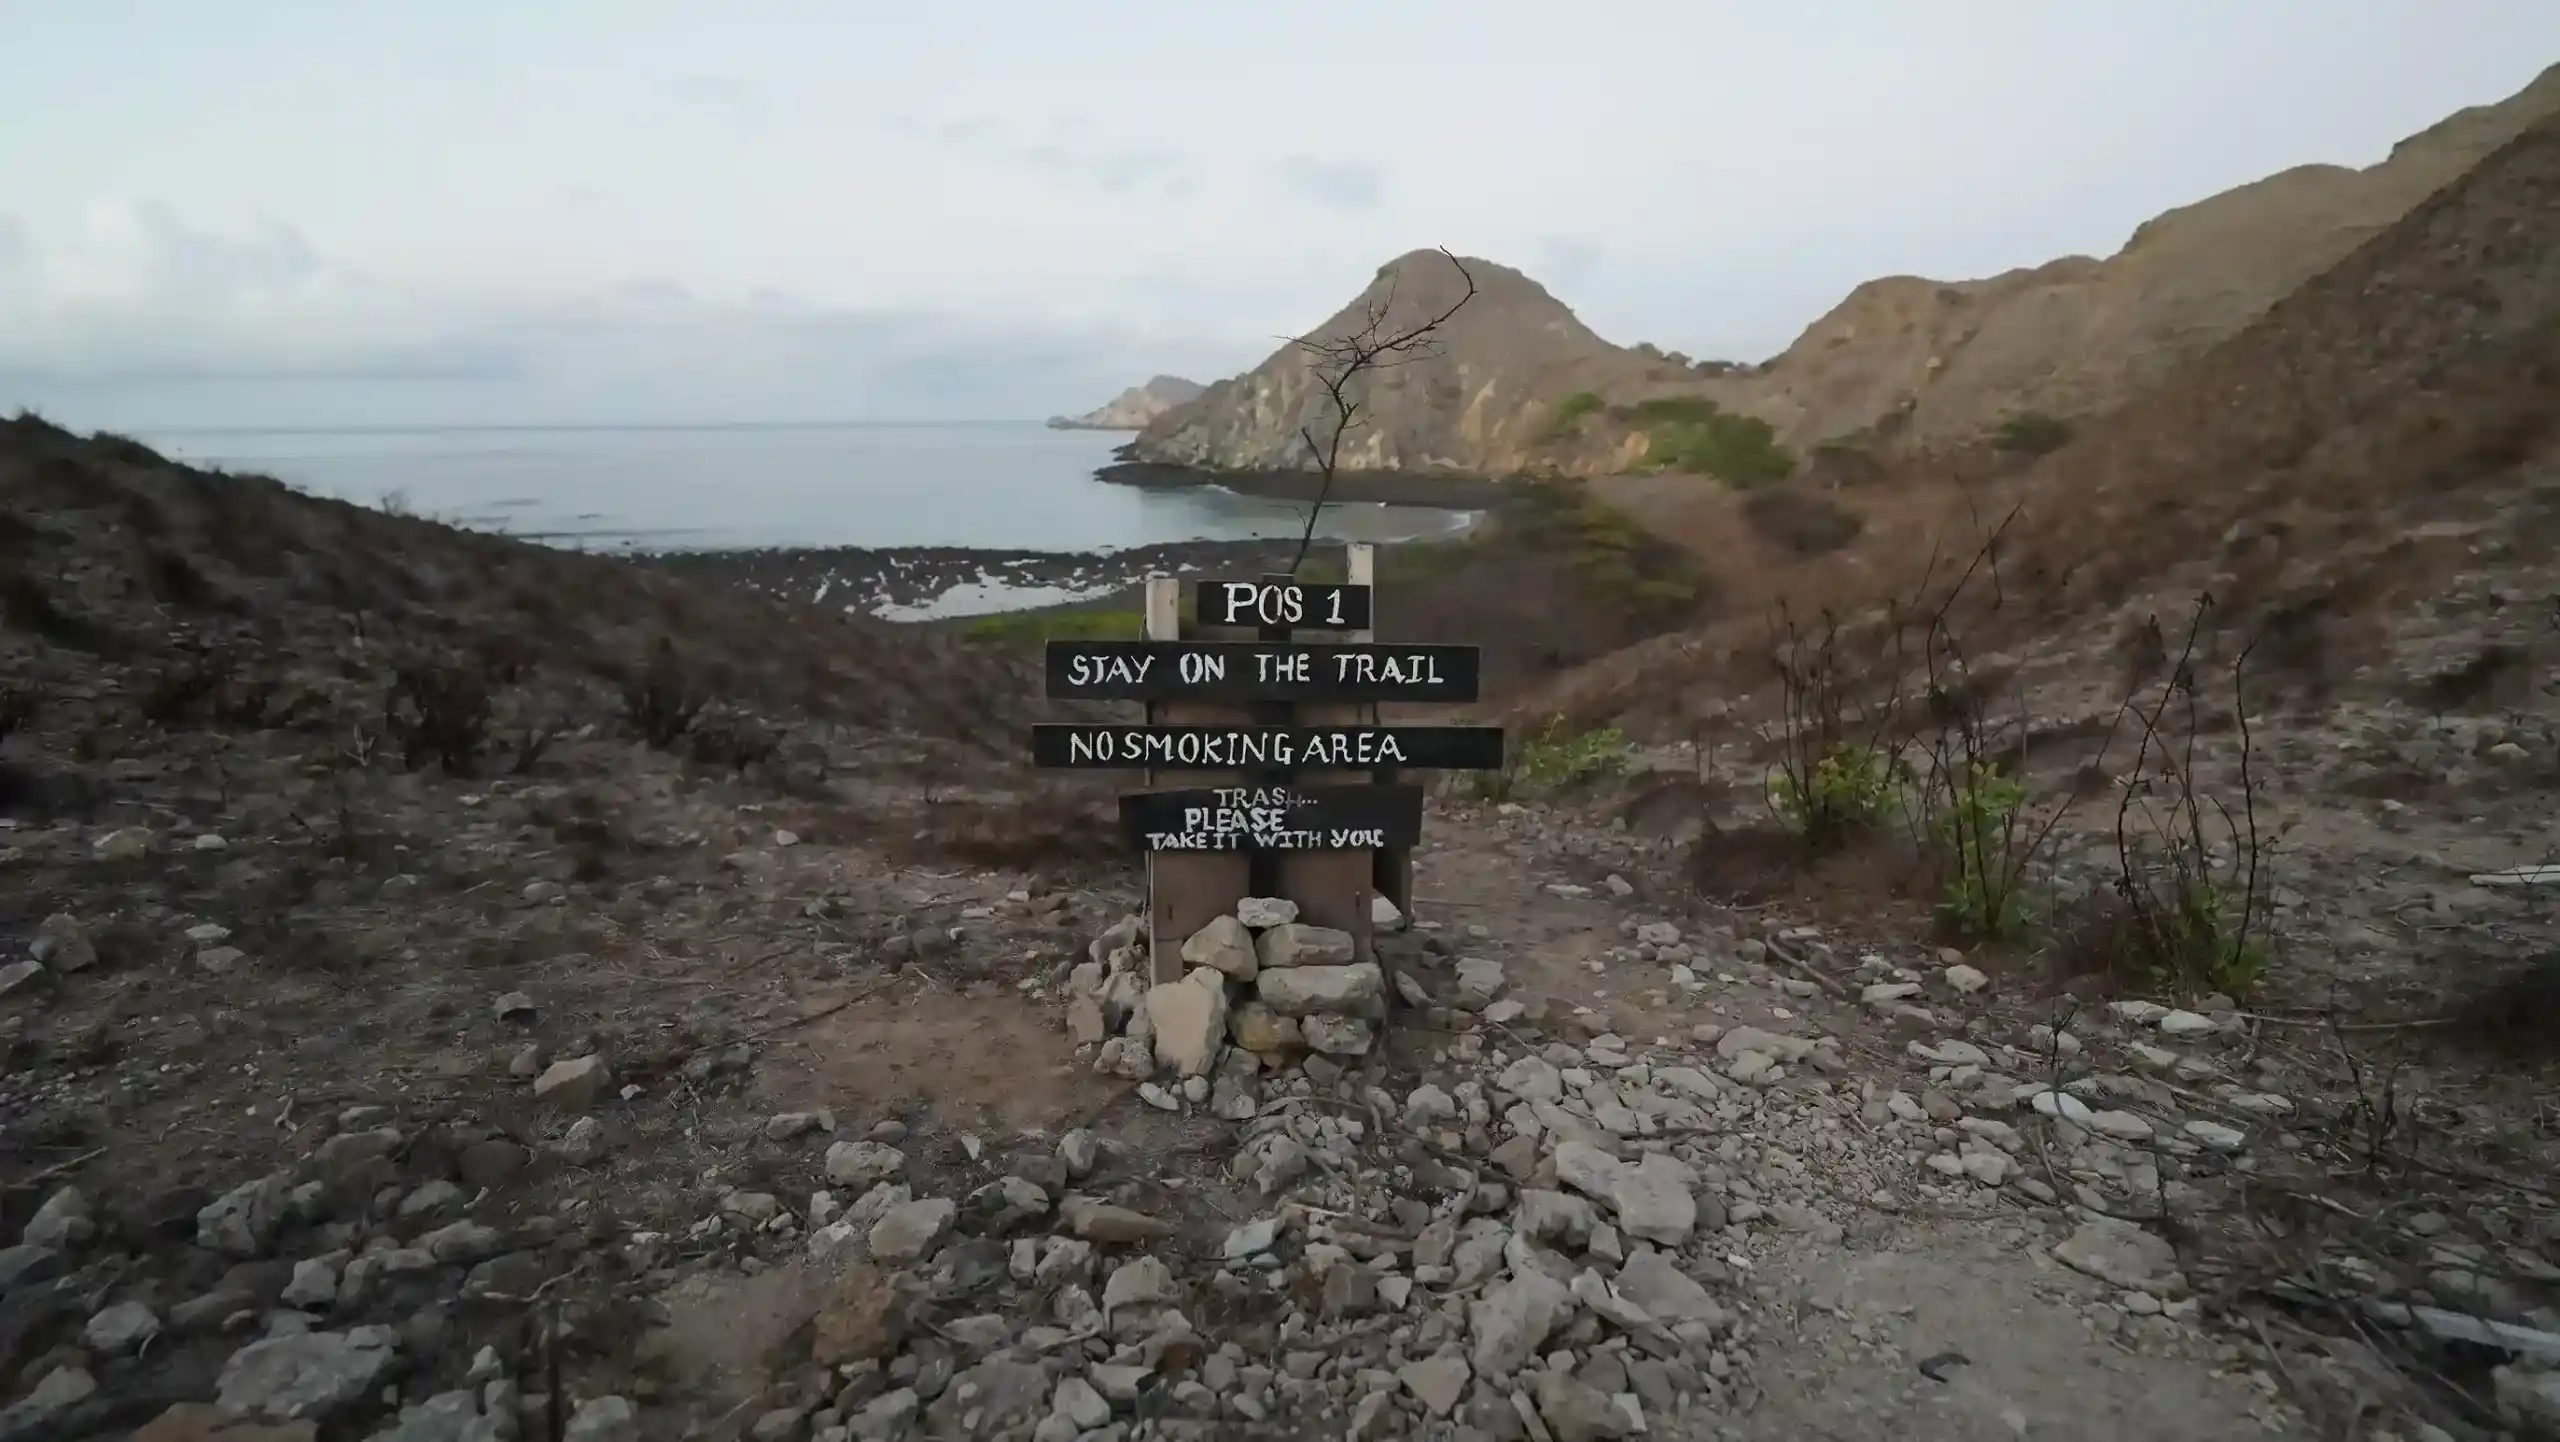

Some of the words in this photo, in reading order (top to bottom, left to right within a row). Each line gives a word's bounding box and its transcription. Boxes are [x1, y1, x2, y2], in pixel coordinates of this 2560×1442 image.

[1222, 583, 1302, 625] POS
[1326, 589, 1345, 624] 1
[1067, 654, 1155, 686] STAY
[1180, 653, 1225, 684] ON
[1254, 653, 1311, 682] THE
[1332, 653, 1444, 684] TRAIL
[1070, 731, 1113, 764] NO
[1121, 732, 1294, 765] SMOKING
[1302, 732, 1407, 763] AREA
[1185, 807, 1287, 833] PLEASE
[1145, 831, 1207, 850] TAKE
[1213, 832, 1244, 849] IT
[1254, 830, 1322, 848] WITH
